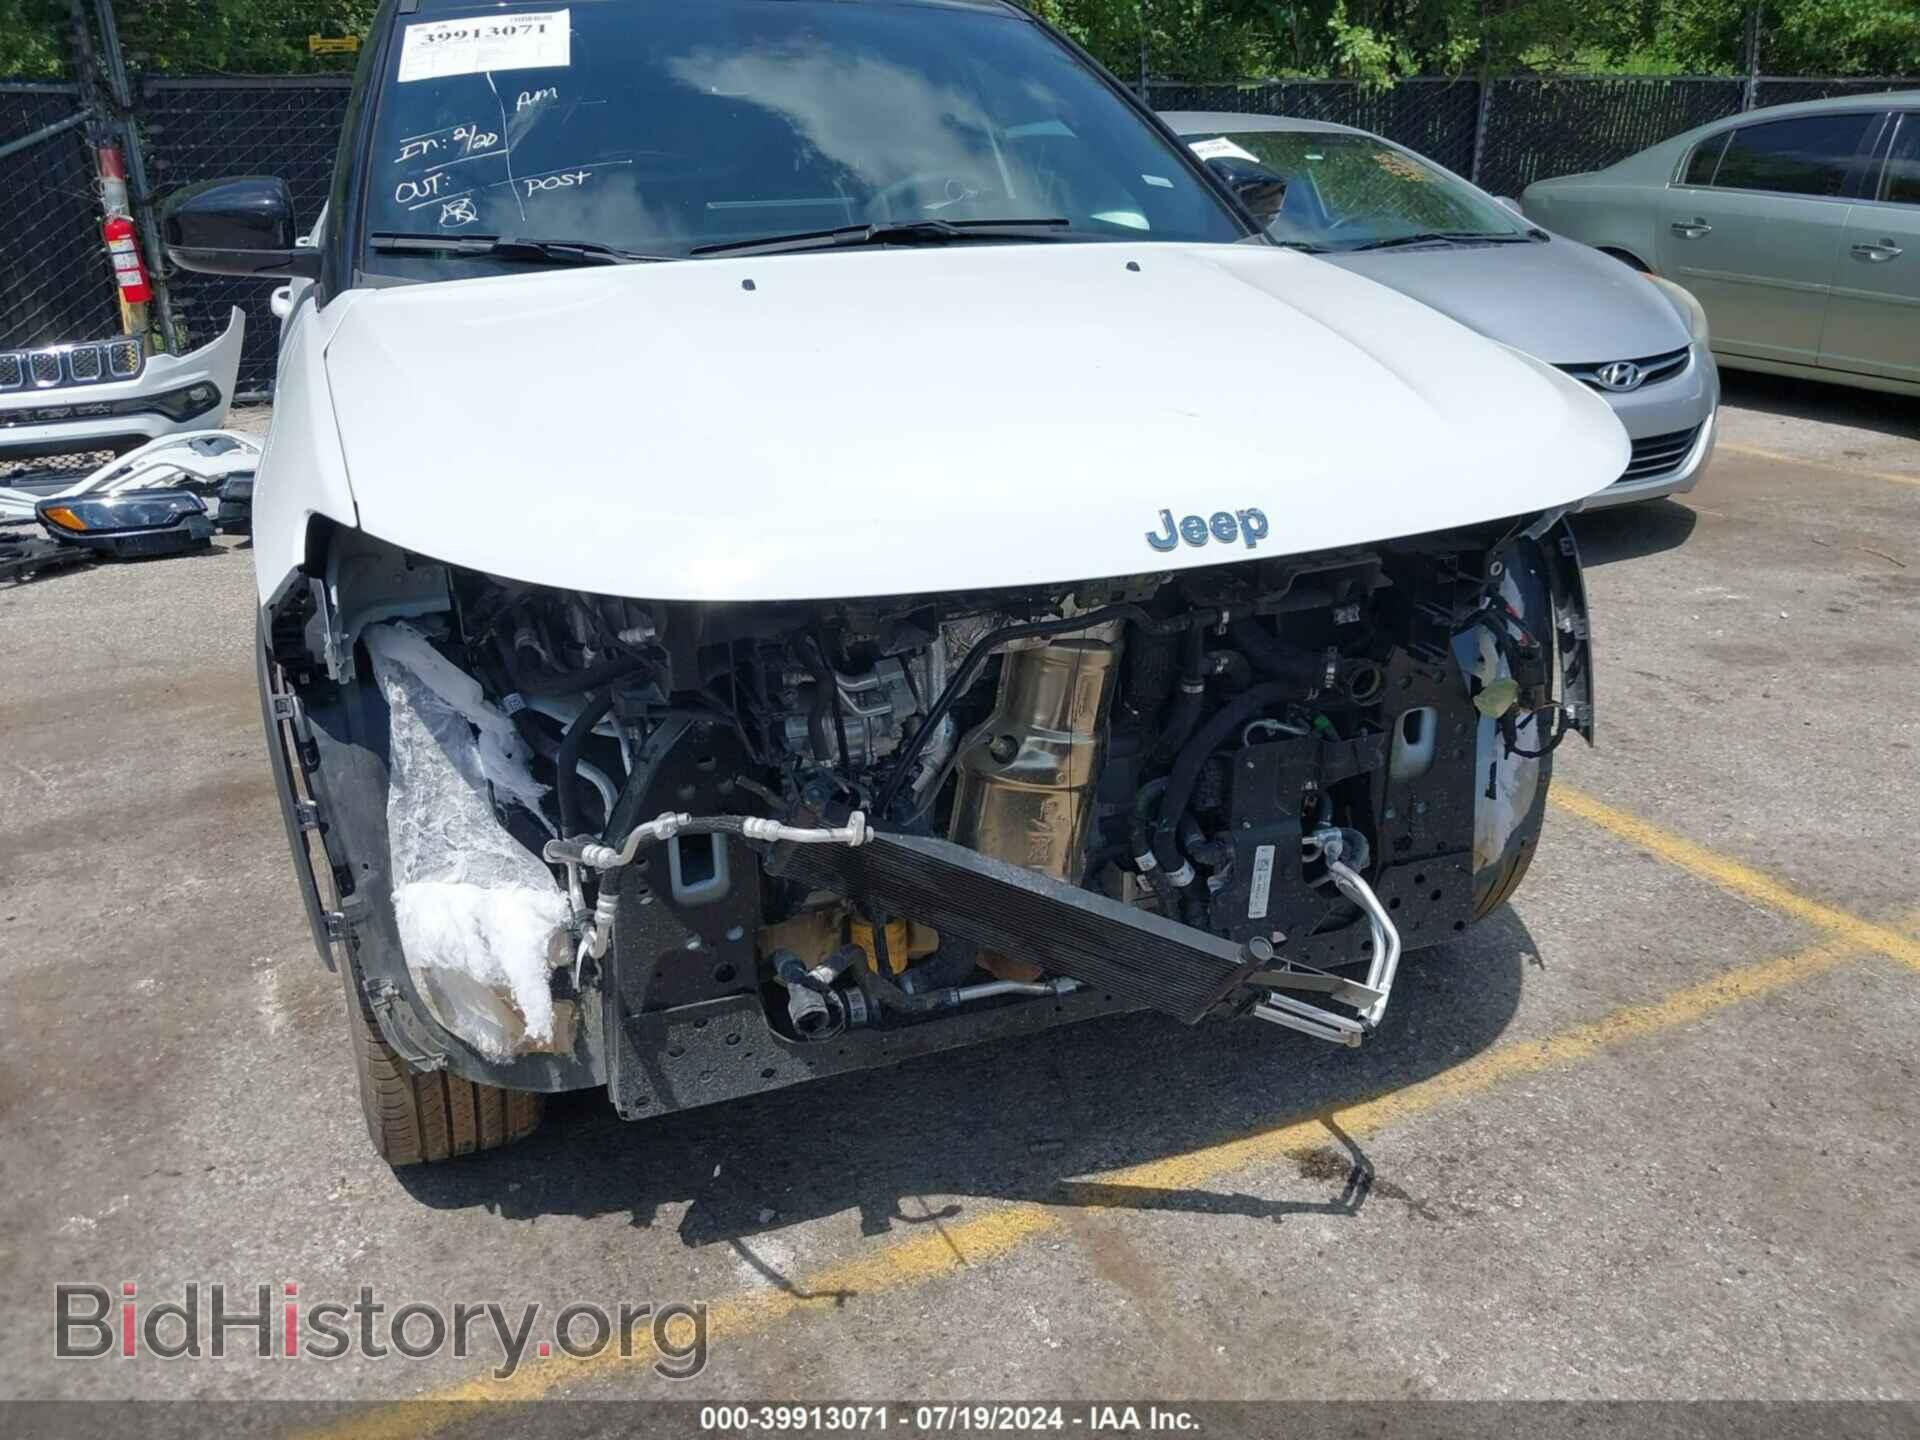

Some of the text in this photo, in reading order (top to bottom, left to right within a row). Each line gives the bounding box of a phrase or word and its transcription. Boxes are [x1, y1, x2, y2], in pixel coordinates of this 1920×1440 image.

[422, 23, 546, 43] 39913071
[395, 172, 451, 203] OUT:
[1145, 507, 1269, 552] Jeep
